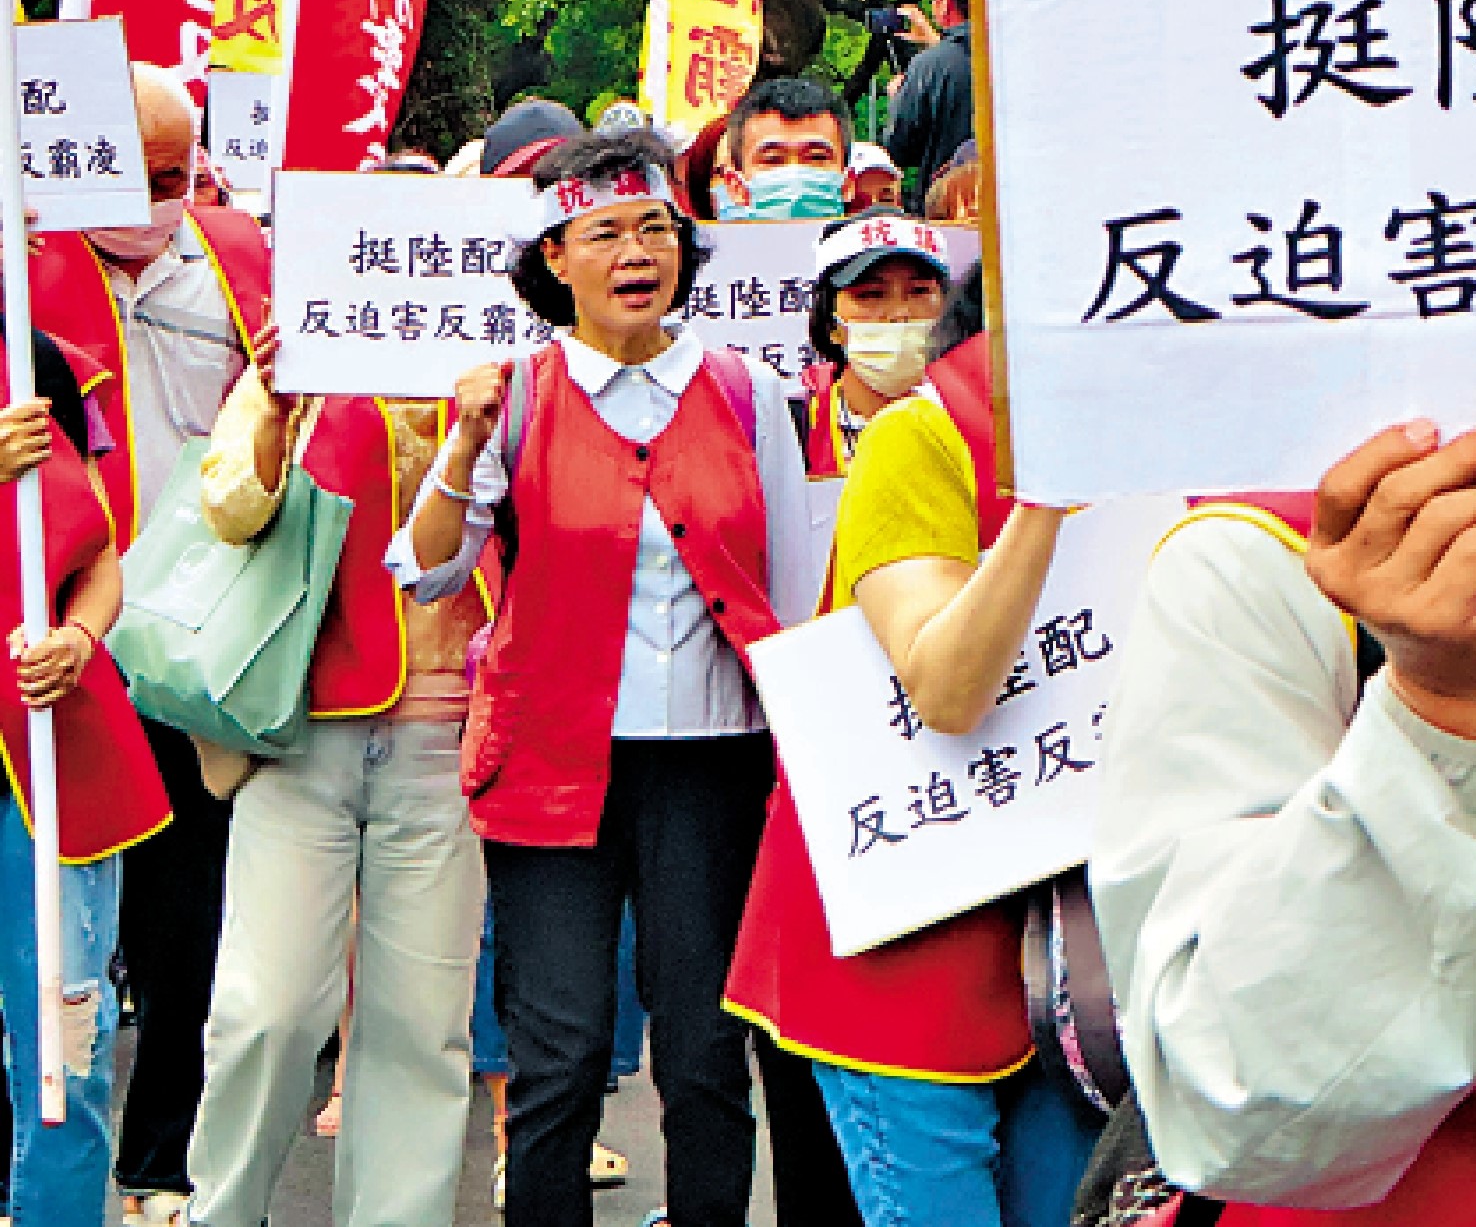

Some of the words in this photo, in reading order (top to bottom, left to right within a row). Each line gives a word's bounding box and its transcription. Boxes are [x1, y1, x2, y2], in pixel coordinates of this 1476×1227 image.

[349, 227, 509, 277] 挺陸配
[847, 702, 1108, 858] 反迫害反
